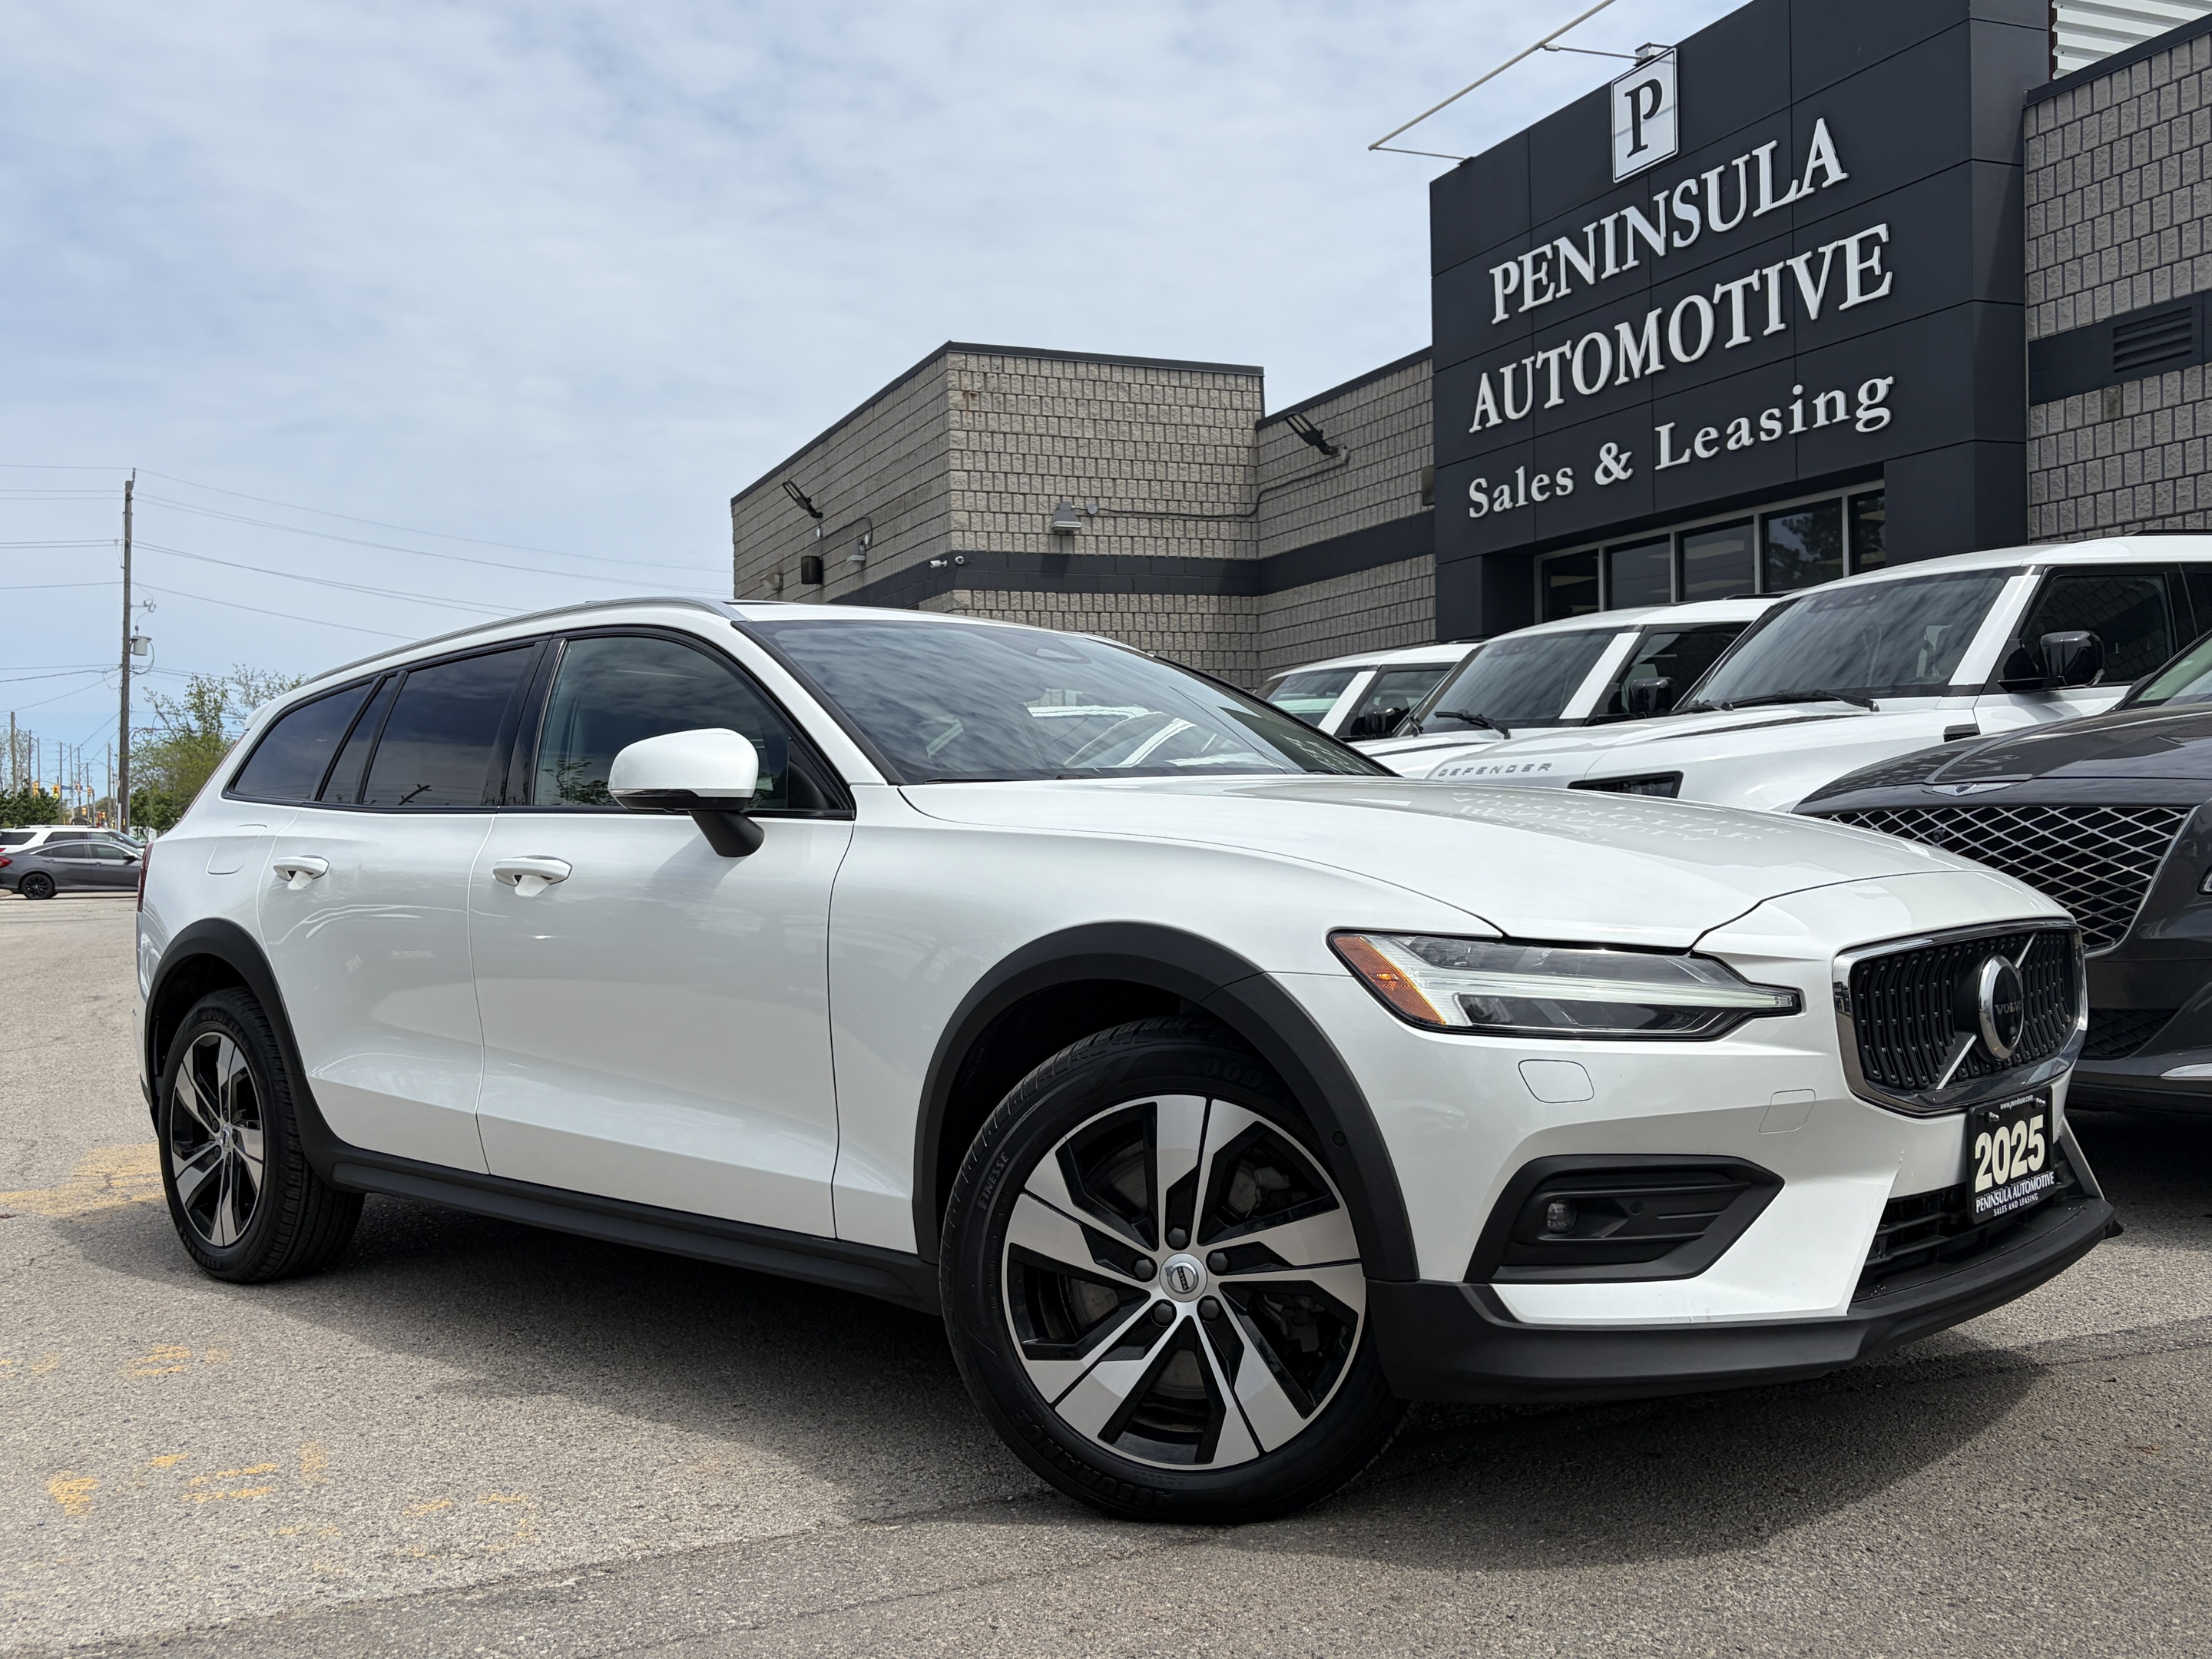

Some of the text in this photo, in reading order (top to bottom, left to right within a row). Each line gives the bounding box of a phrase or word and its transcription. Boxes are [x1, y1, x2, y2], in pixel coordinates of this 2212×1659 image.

[1624, 78, 1663, 158] P
[1489, 118, 1849, 324] PENINSULA
[1469, 223, 1894, 433] AUTOMOTIVE
[1469, 376, 1895, 518] Sales & Leasing
[1438, 762, 1552, 777] DEFENDER
[977, 1151, 1009, 1211] FINESSE
[1975, 1114, 2045, 1193] 2025
[1975, 1171, 2055, 1214] PENINSULA AUTOMOTIVE
[1993, 1193, 2038, 1217] SALES AND LEASING
